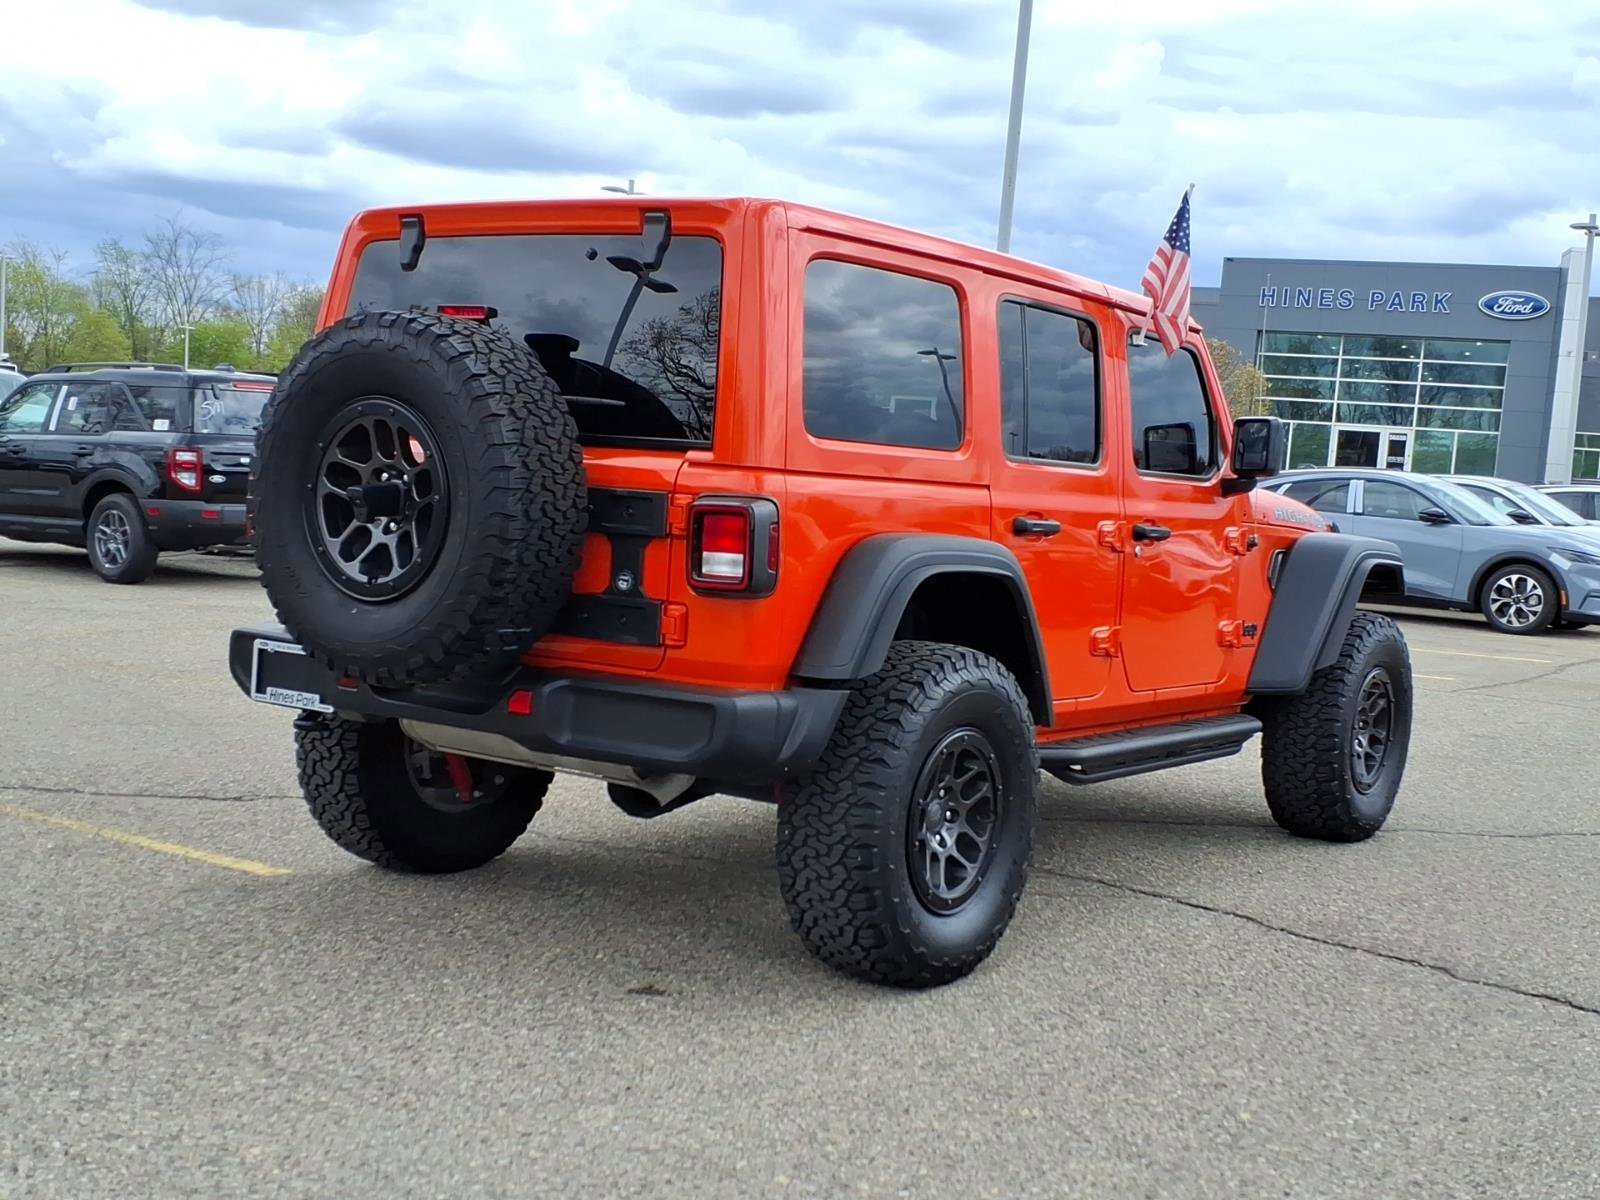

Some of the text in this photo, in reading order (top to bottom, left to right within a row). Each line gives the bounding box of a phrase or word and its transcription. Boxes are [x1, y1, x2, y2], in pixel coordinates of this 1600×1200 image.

[1259, 286, 1452, 313] HINES PARK
[1492, 296, 1534, 315] Ford
[269, 688, 318, 707] Hines Park
